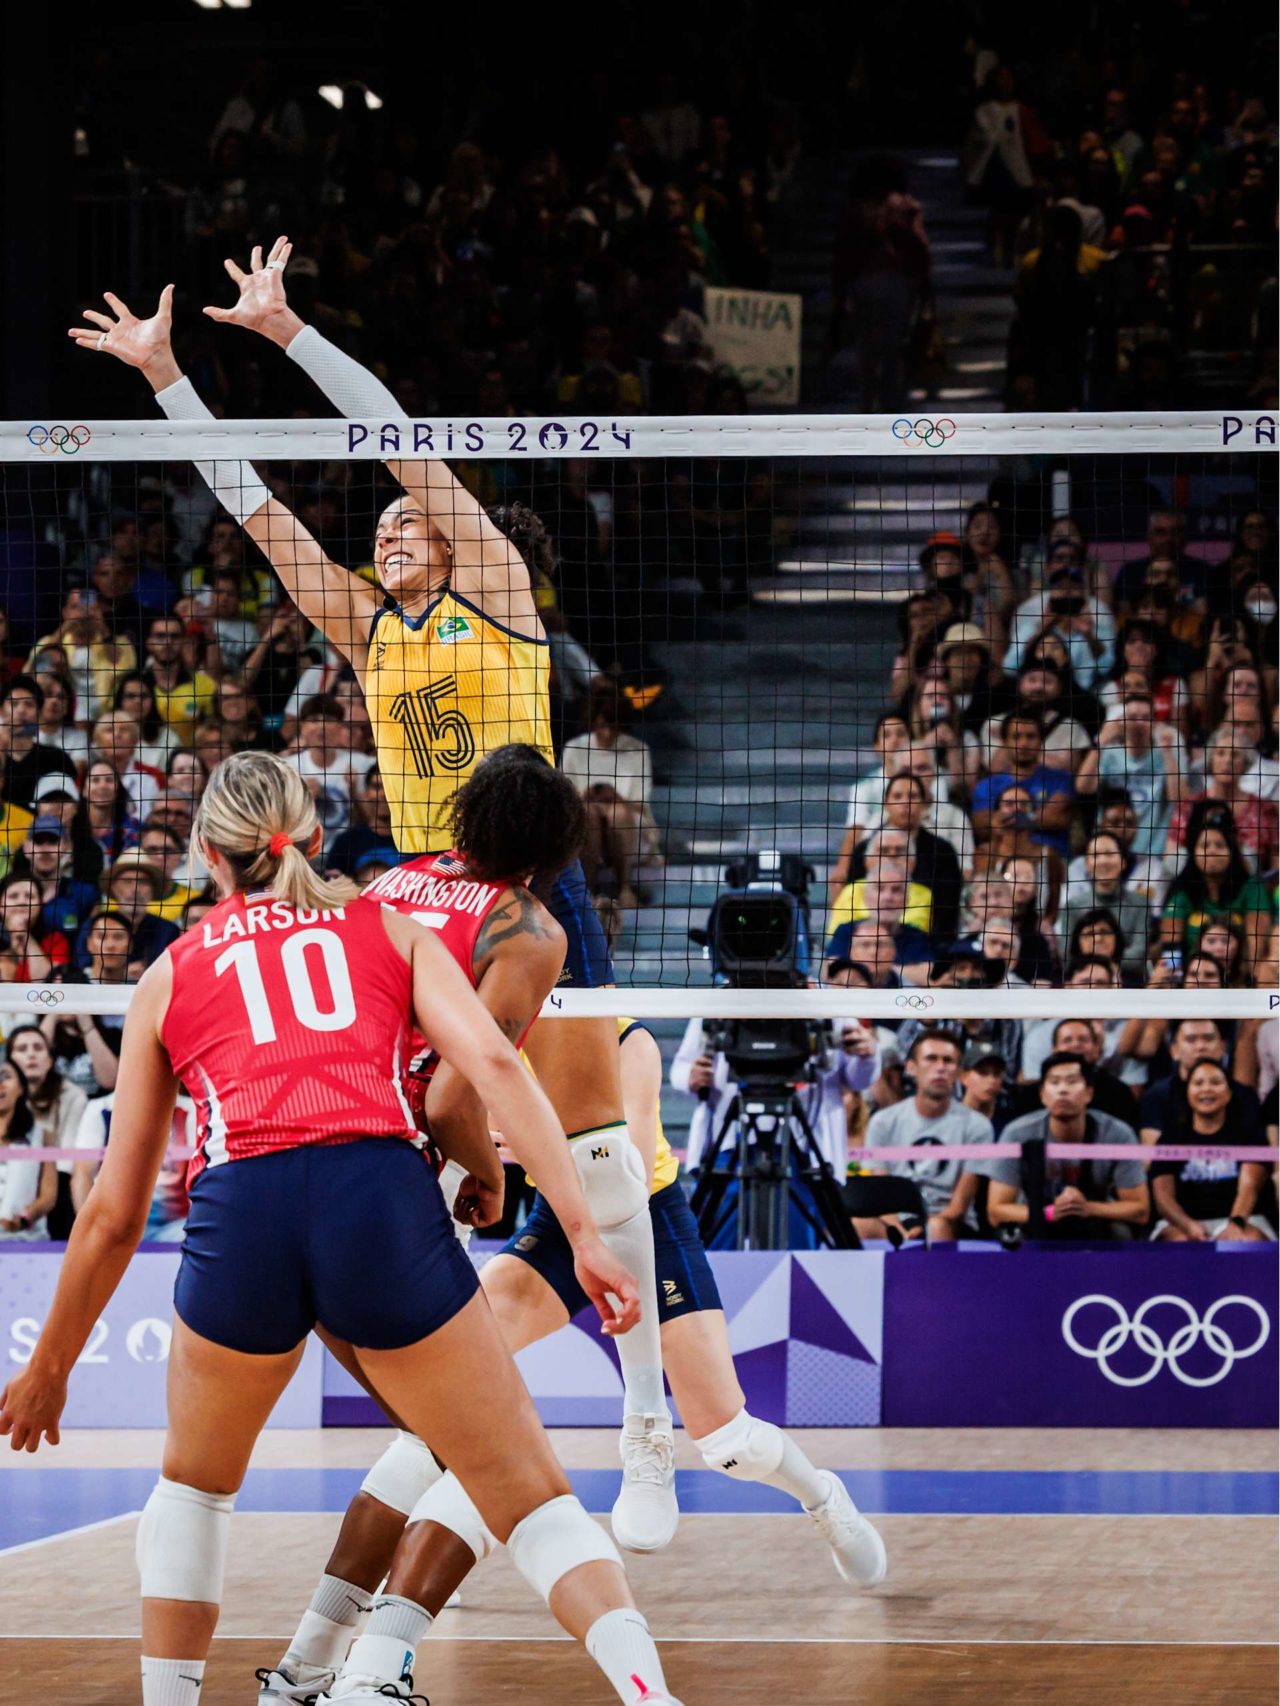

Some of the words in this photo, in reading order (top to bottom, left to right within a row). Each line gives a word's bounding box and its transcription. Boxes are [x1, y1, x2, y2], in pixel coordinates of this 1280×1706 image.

[507, 421, 631, 452] 2024
[388, 674, 476, 780] 15
[360, 866, 498, 917] WASHINGTON
[203, 900, 347, 949] LARSON
[215, 928, 357, 1046] 10
